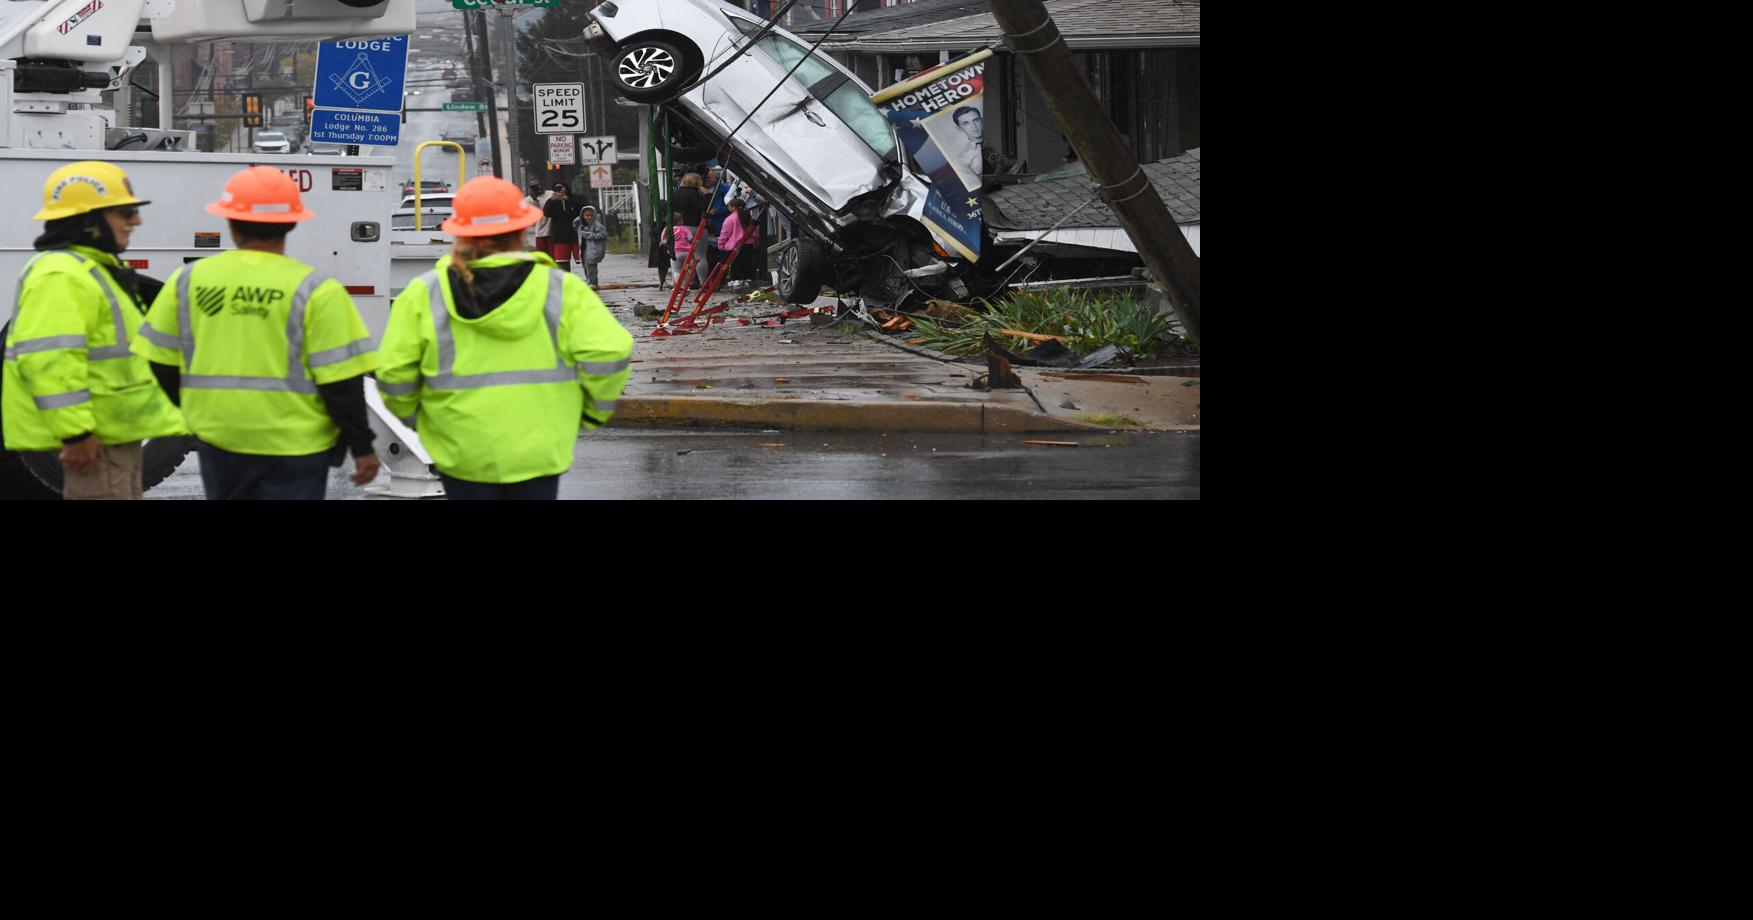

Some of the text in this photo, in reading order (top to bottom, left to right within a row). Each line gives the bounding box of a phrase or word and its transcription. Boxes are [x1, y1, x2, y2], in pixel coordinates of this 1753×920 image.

[336, 41, 392, 52] LODGE
[349, 71, 371, 90] G
[891, 62, 985, 111] HOMETOWN
[538, 88, 580, 97] SPEED
[921, 83, 972, 113] HERO
[543, 98, 576, 107] LIMIT
[334, 113, 380, 123] COLUMBIA
[541, 109, 579, 128] 25
[324, 122, 388, 133] Lodge No. 286
[328, 131, 365, 142] Thursday
[368, 133, 398, 143] 7:00PM
[231, 286, 285, 304] AWP
[230, 304, 270, 320] Safety
